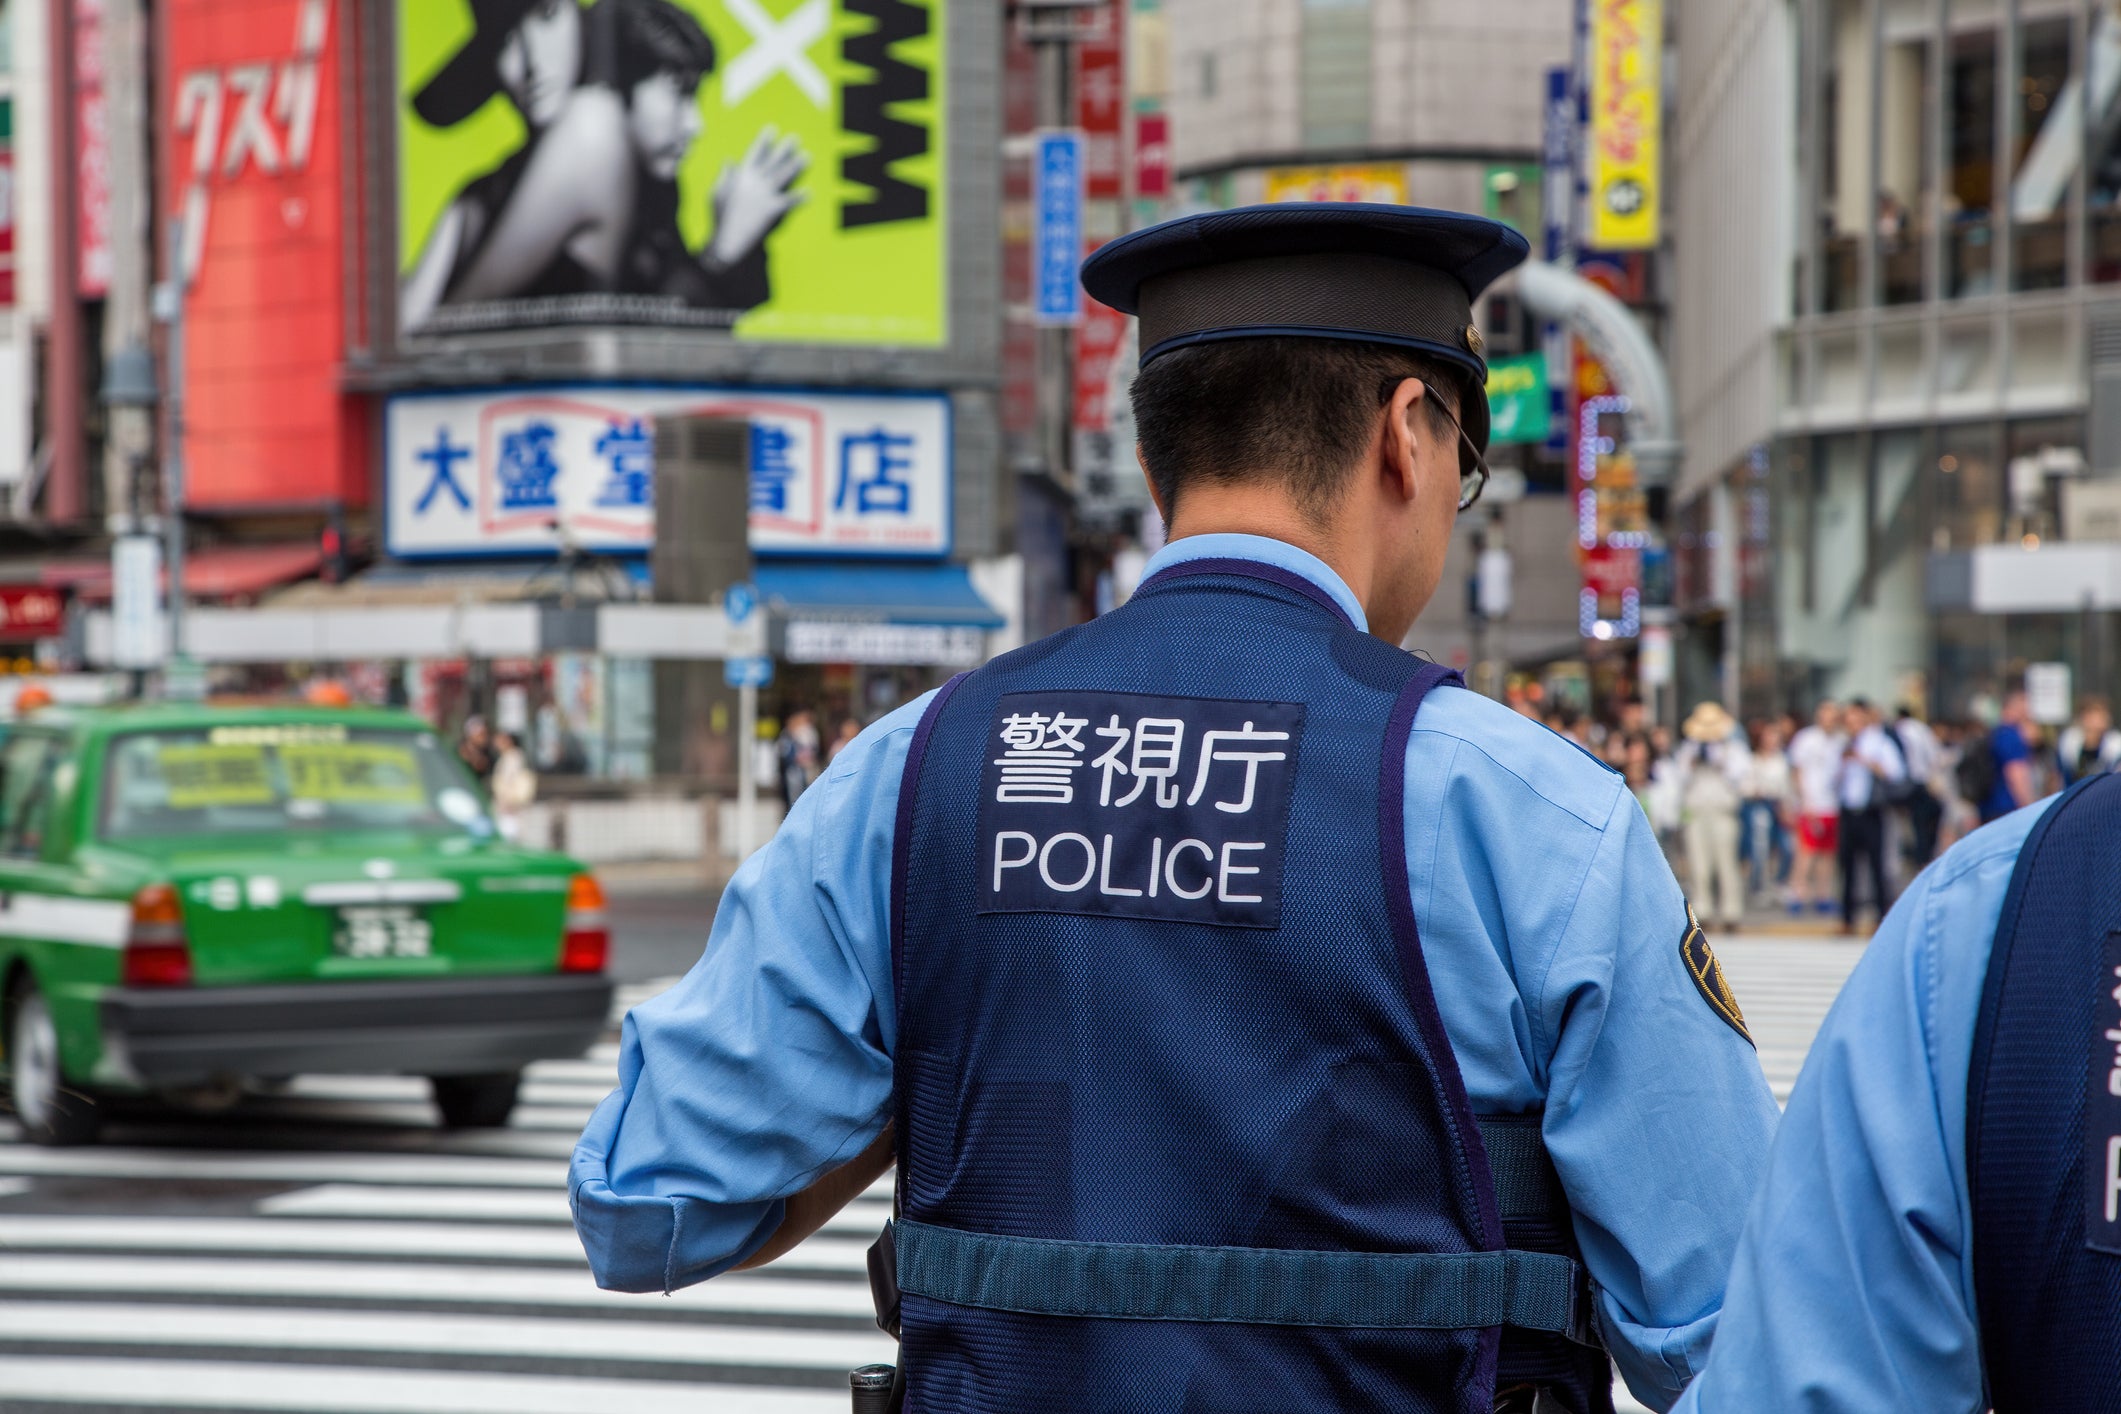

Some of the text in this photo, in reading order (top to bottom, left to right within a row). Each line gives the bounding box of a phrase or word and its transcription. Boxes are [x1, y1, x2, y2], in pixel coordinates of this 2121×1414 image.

[993, 711, 1290, 814] 警視庁
[993, 831, 1267, 903] POLICE
